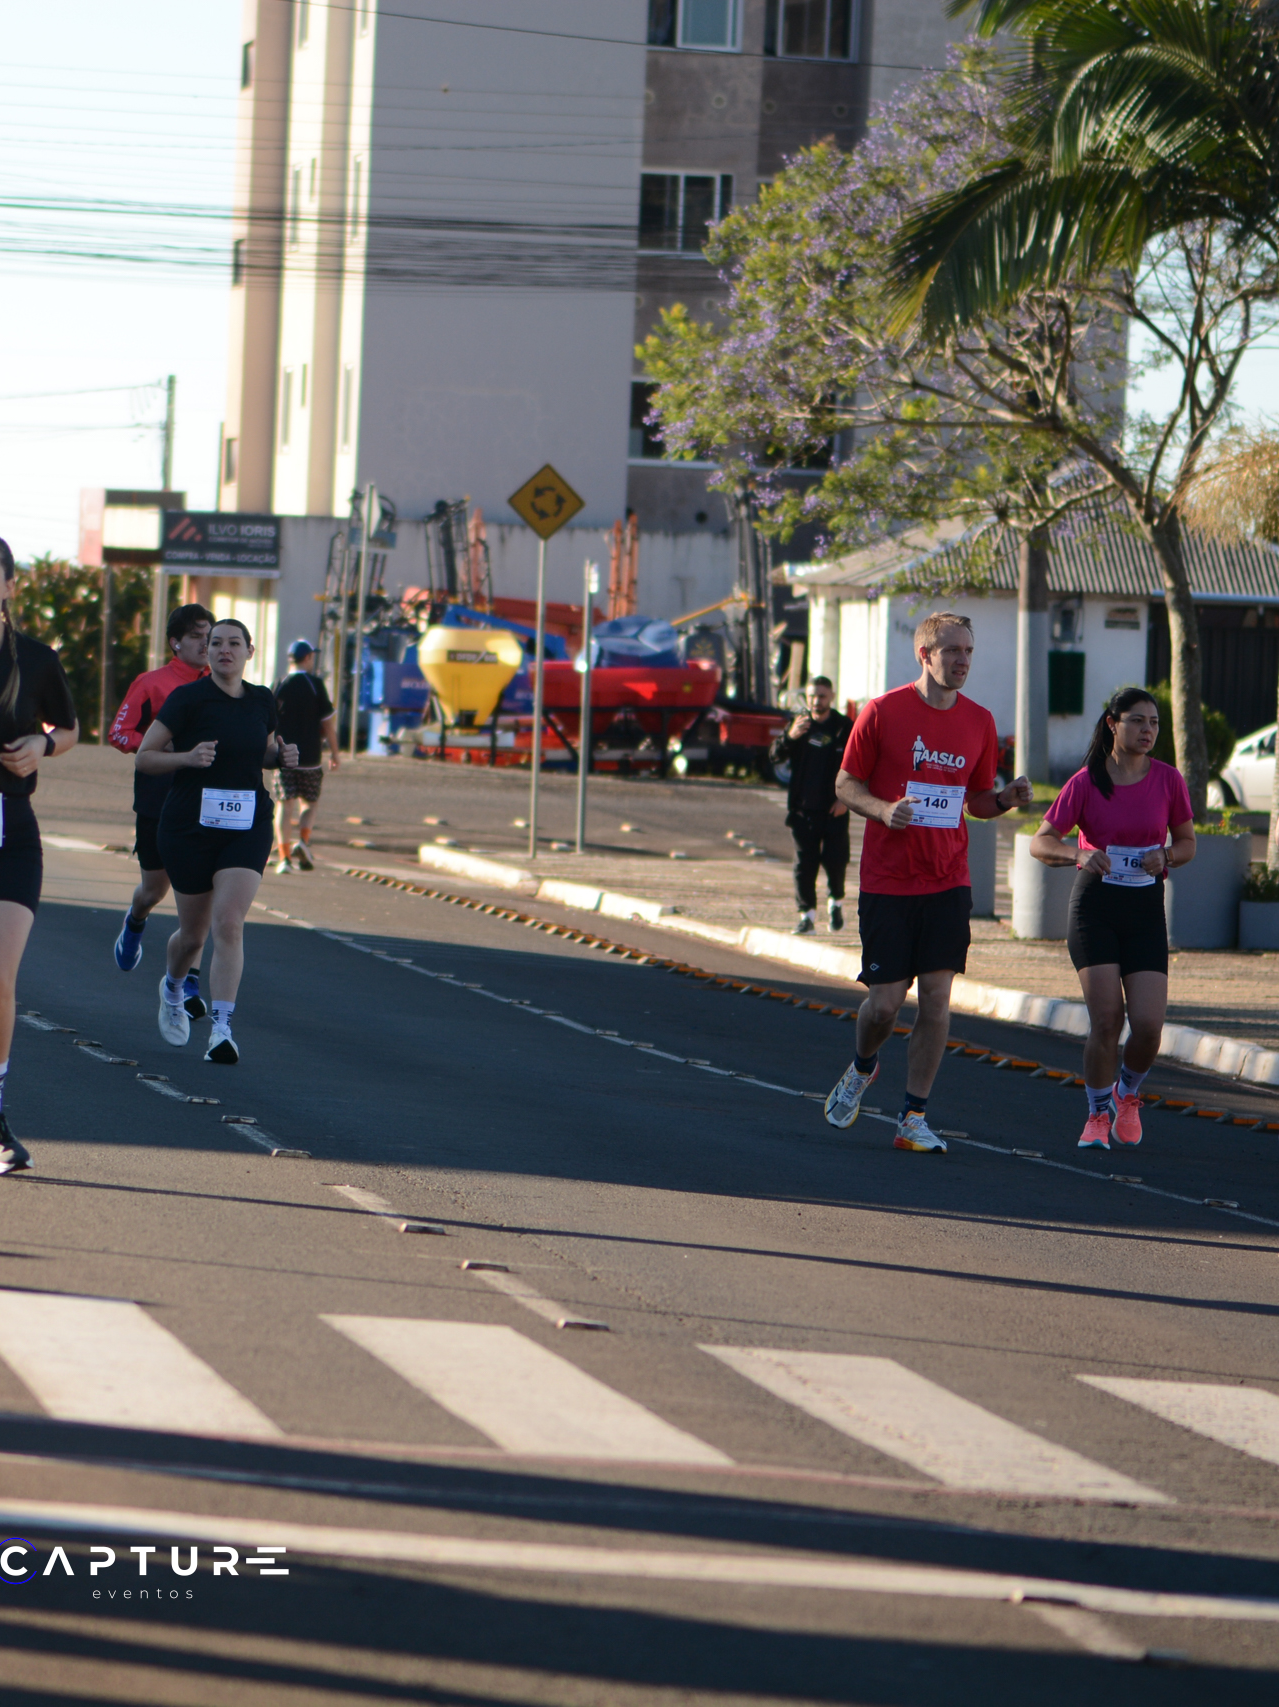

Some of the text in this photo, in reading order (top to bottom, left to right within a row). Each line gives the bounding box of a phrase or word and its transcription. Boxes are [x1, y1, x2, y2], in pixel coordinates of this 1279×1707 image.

[208, 524, 276, 537] ILVO IORIS
[165, 551, 199, 560] COMPRA
[205, 553, 231, 562] VENDA
[237, 553, 277, 564] LOCAÇÃO
[921, 749, 966, 769] AASLO
[218, 801, 242, 812] 150
[923, 796, 949, 810] 140
[1122, 856, 1143, 869] 16
